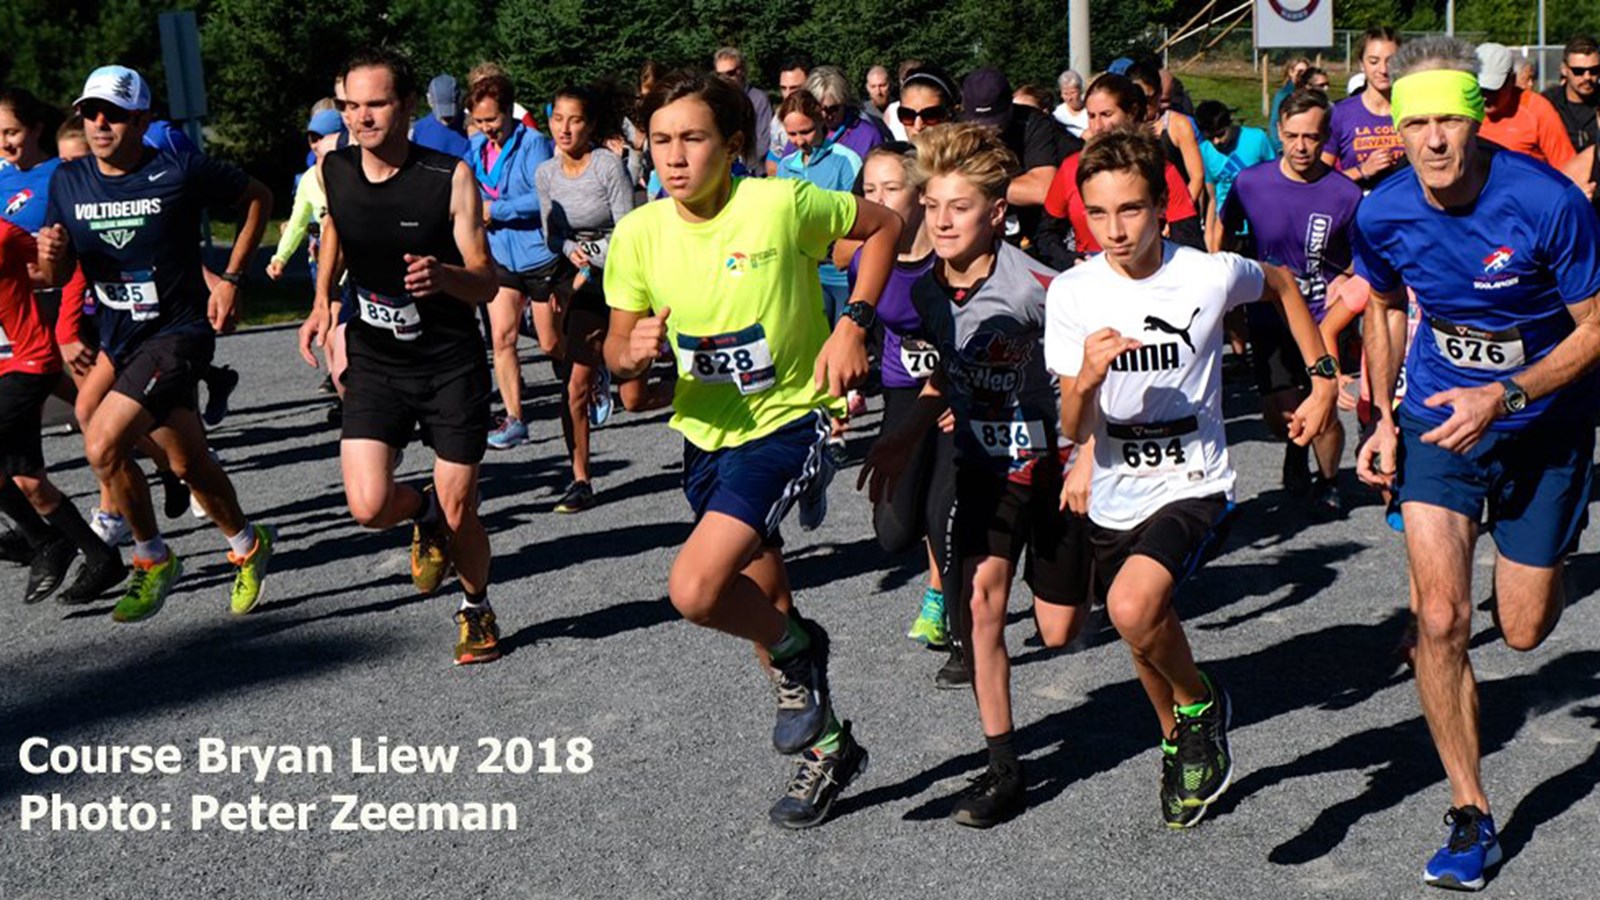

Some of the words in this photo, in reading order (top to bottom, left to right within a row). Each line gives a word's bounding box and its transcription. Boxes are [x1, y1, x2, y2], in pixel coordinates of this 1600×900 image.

[1355, 126, 1372, 136] LA
[1356, 136, 1392, 148] BRYAN
[75, 198, 162, 220] VOLTIGEURS
[105, 285, 143, 303] 835
[367, 303, 407, 325] 834
[695, 348, 754, 376] 828
[1110, 342, 1180, 372] UMA
[1446, 338, 1505, 364] 676
[982, 424, 1030, 447] 836
[1122, 437, 1186, 468] 694
